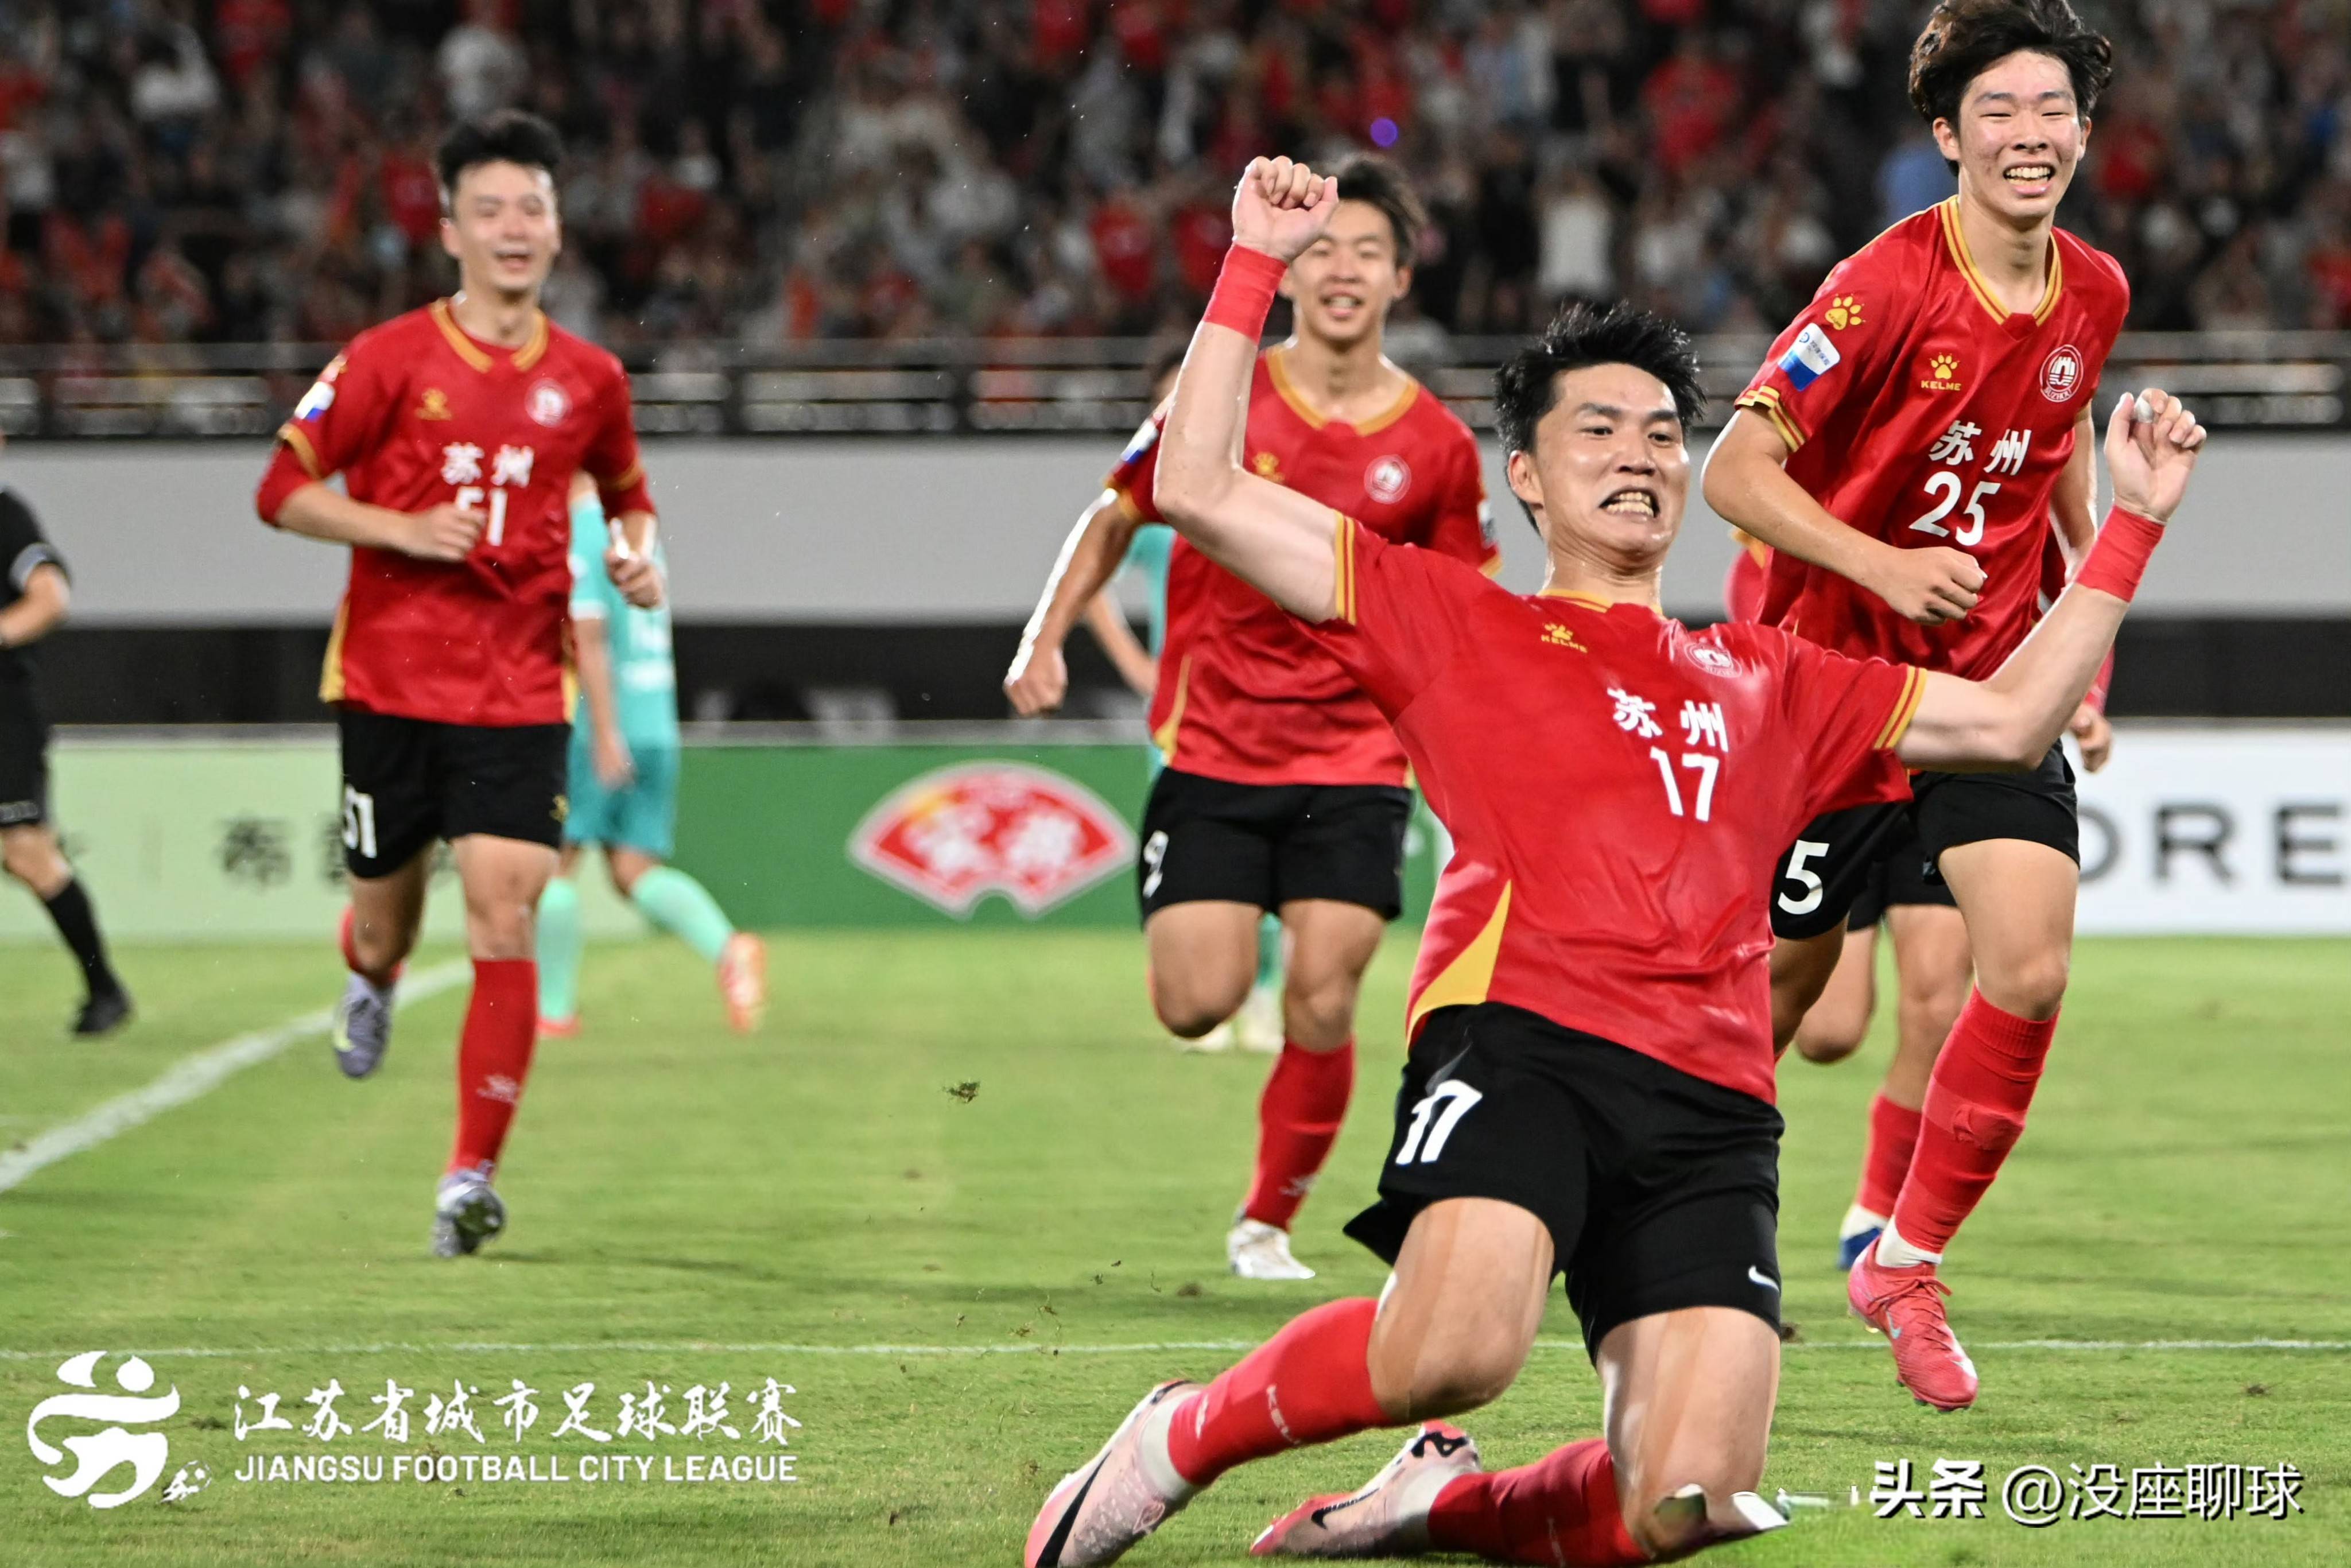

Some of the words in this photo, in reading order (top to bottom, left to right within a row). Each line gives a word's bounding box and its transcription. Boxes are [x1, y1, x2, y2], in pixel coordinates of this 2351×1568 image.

[1921, 380, 1962, 391] KELME
[441, 441, 534, 488] 苏州
[1929, 420, 2032, 476] 苏州
[1908, 471, 2001, 546] 25
[1607, 688, 1729, 753] 苏州
[1650, 746, 1719, 822] 17
[1395, 1079, 1483, 1165] 17
